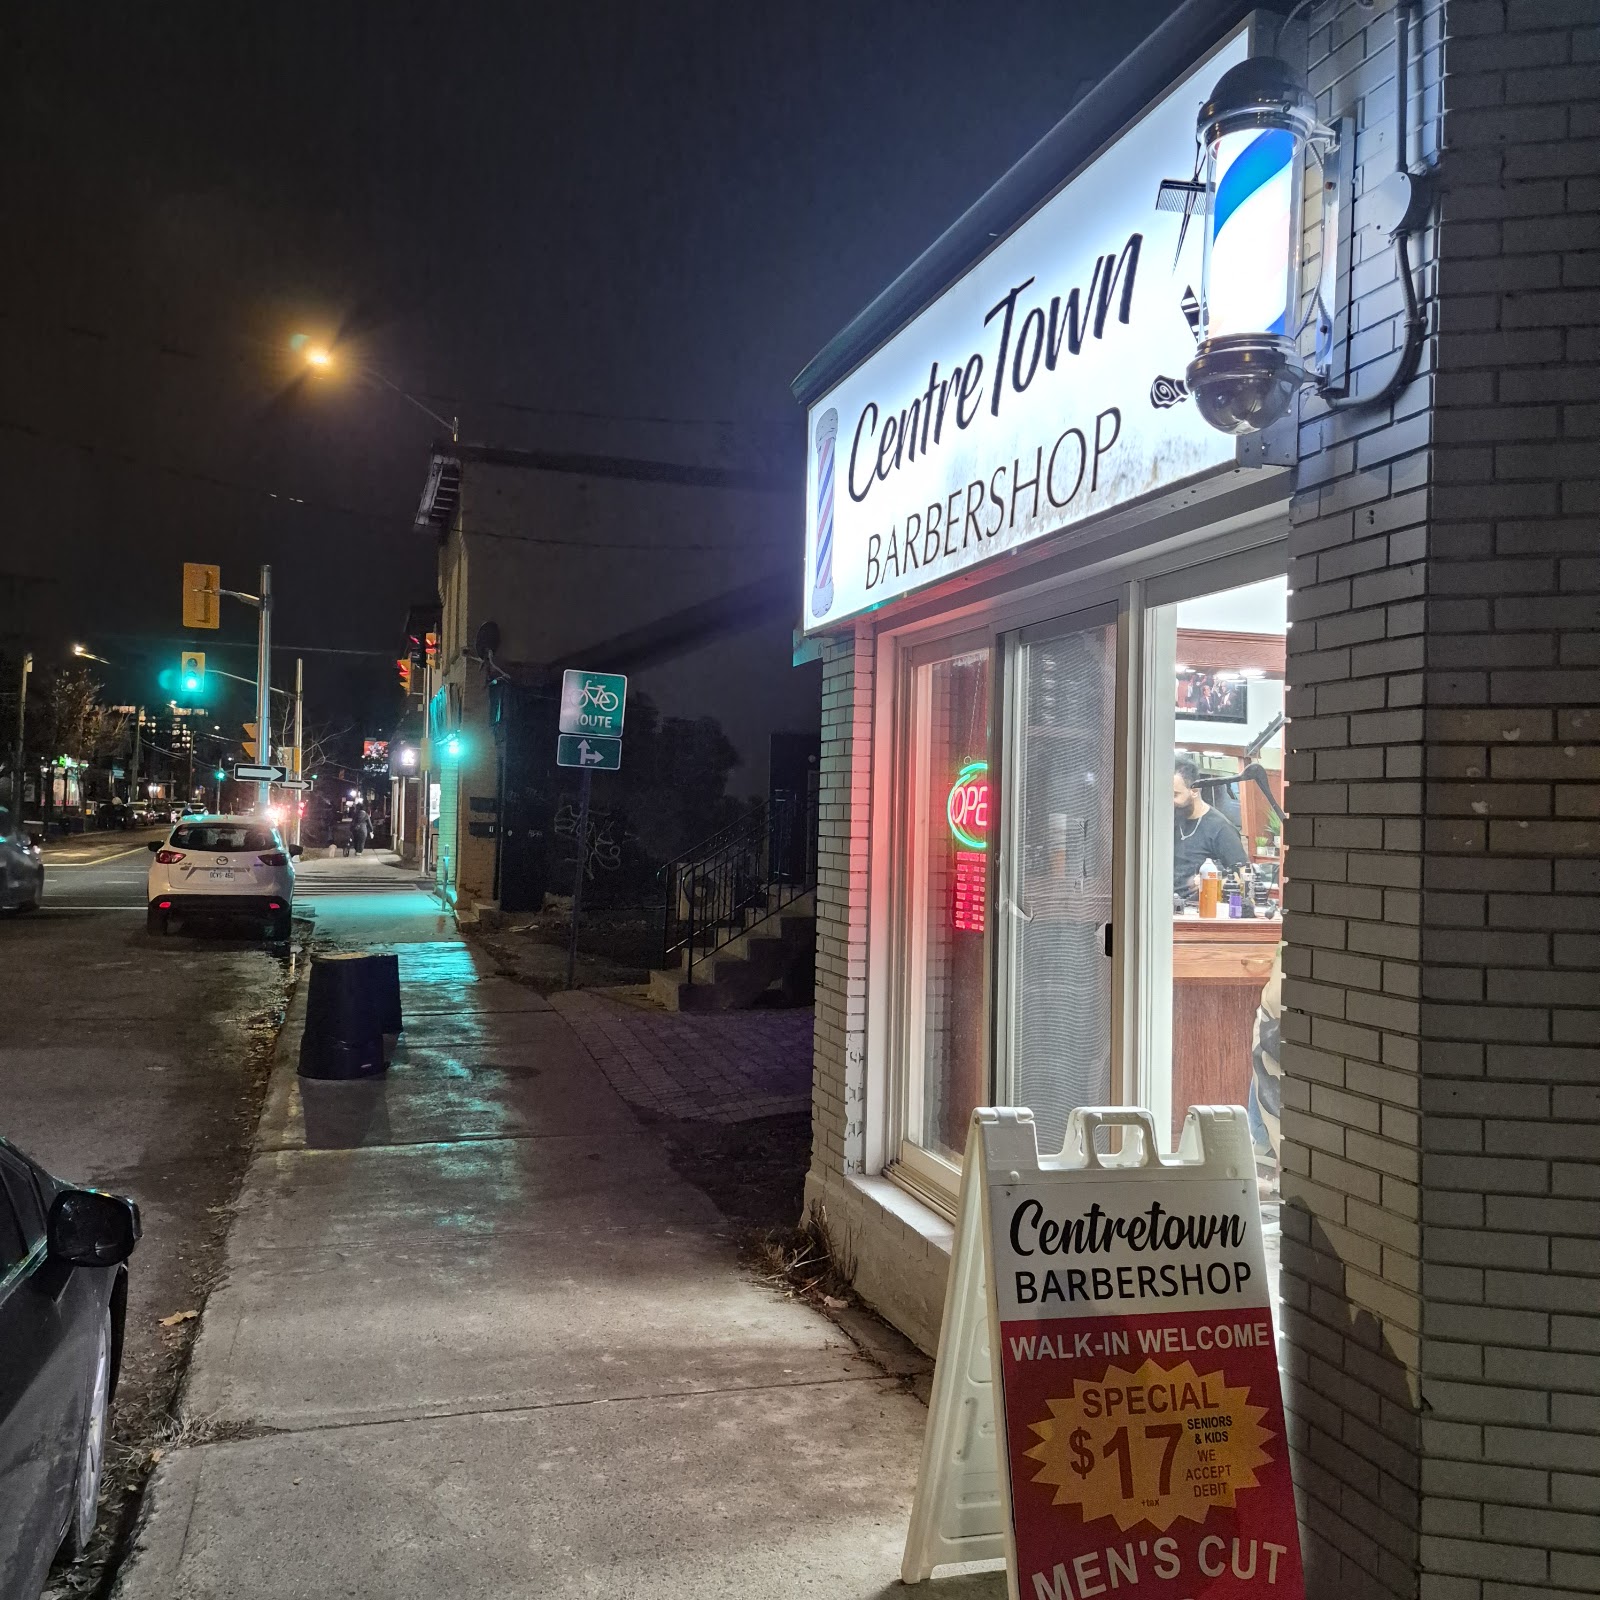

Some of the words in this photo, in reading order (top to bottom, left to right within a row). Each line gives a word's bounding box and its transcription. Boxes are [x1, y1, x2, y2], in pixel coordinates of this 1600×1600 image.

[865, 406, 1122, 591] BARBERSHOP
[952, 786, 988, 826] OPE
[1010, 1199, 1247, 1256] Centretown
[1015, 1261, 1251, 1304] BARBERSHOP
[1009, 1331, 1130, 1361] WALK-IN
[1137, 1322, 1270, 1353] WELCOME
[1083, 1382, 1220, 1418] SPECIAL
[1187, 1415, 1233, 1430] SENIORS
[1194, 1433, 1202, 1445] &
[1205, 1431, 1229, 1443] KIDS
[1069, 1422, 1184, 1500] $17
[1186, 1464, 1232, 1481] ACCEPT
[1197, 1449, 1216, 1462] WE
[1193, 1482, 1227, 1498] DEBIT
[1031, 1537, 1181, 1600] MEN'S
[1198, 1535, 1288, 1585] CUT
